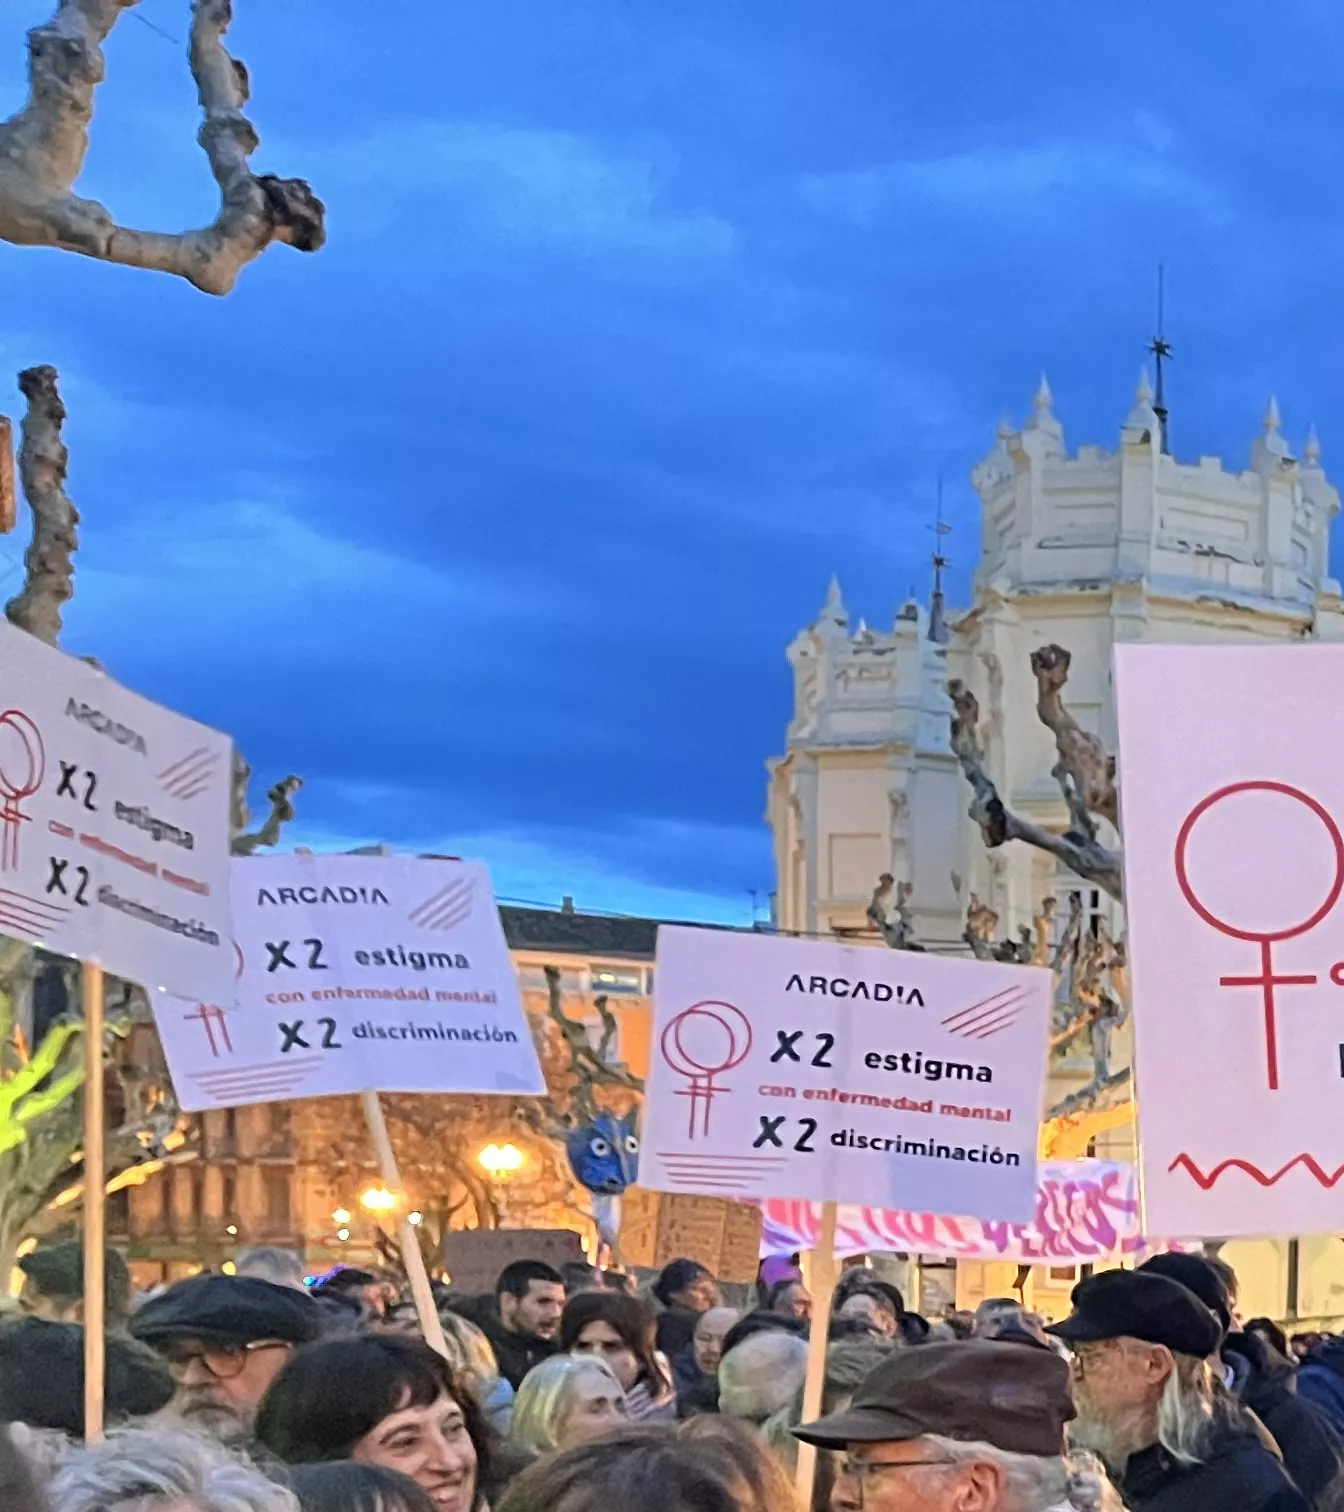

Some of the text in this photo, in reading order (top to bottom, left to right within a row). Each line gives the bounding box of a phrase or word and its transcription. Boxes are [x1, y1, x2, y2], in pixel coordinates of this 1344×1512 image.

[355, 945, 469, 970] estigma
[266, 986, 497, 1004] con enfermedad mental
[352, 1022, 517, 1042] discriminación
[865, 1052, 992, 1082] estigma
[759, 1085, 1011, 1122] con enfermedad mental
[831, 1129, 1019, 1166] discriminación
